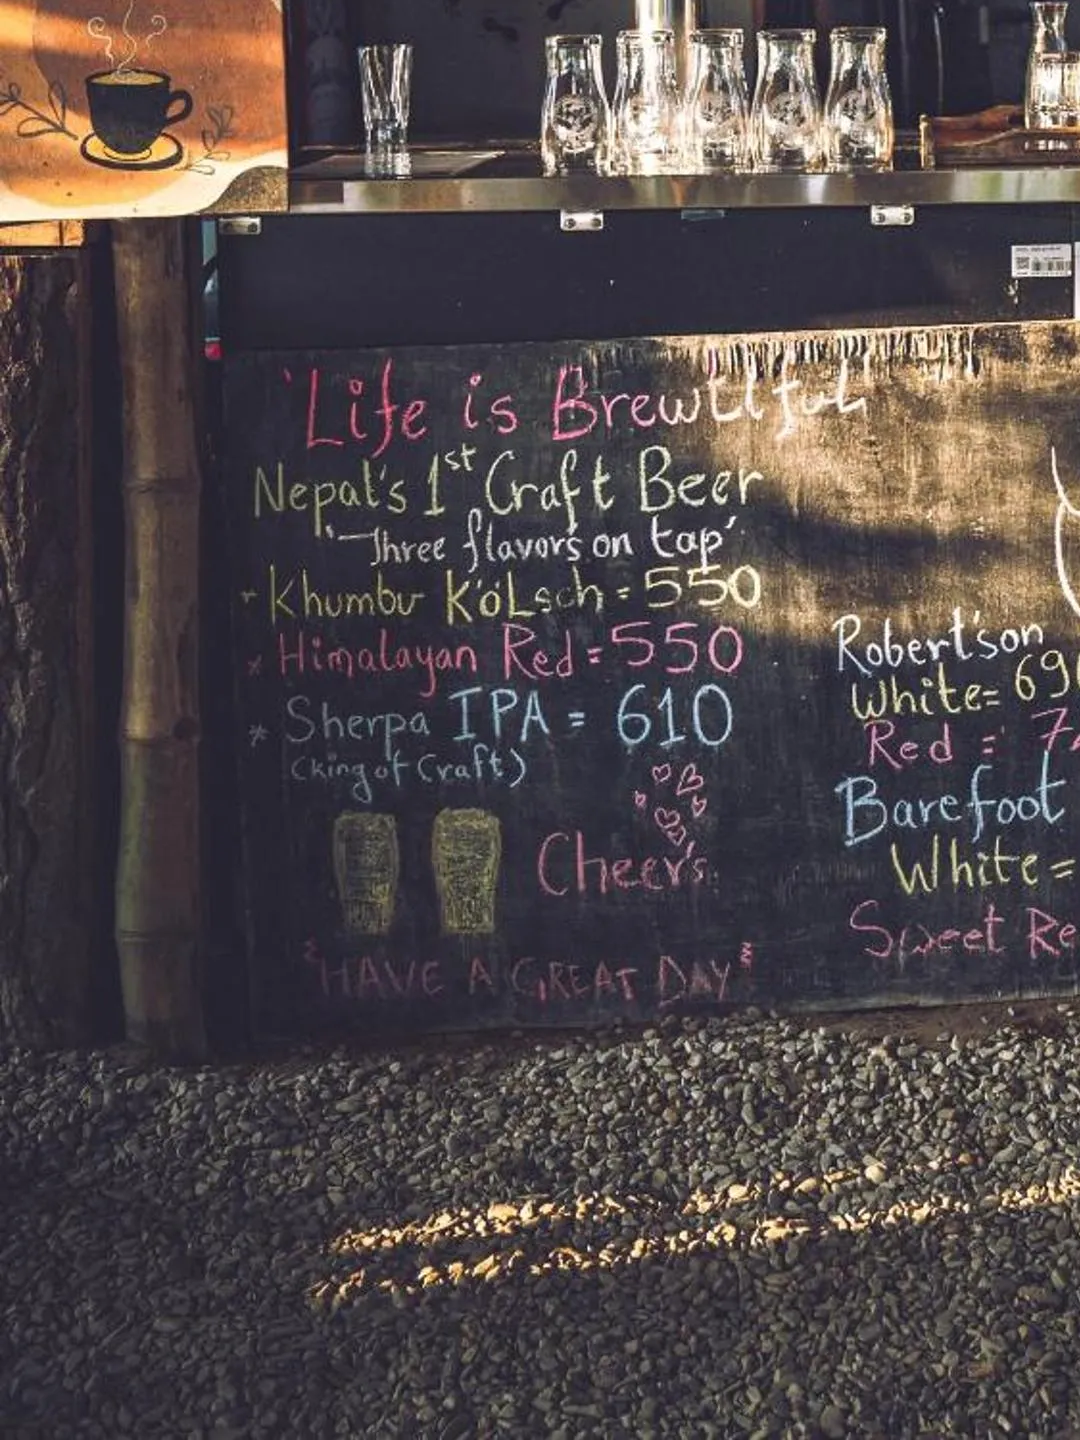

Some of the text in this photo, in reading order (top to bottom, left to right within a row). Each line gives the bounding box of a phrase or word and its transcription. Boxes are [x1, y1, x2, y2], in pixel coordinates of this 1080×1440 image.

[461, 372, 519, 434] is
[253, 459, 408, 539] Nepal's
[485, 447, 615, 538] Craft
[637, 444, 764, 514] Beer
[461, 508, 583, 575] flavors
[592, 531, 633, 560] on
[269, 561, 427, 625] Khumbu
[643, 564, 762, 611] 550
[278, 620, 744, 699] Himalayan Red 550
[850, 661, 984, 722] White
[285, 682, 735, 761] Sherpa IPA 610
[861, 719, 955, 772] Red
[374, 749, 409, 787] of
[834, 748, 1068, 848] Barefoot
[890, 832, 1039, 897] White
[849, 898, 1005, 958] Sweet
[315, 956, 448, 1002] HAVE
[467, 957, 494, 997] A
[509, 956, 638, 1004] GREAT
